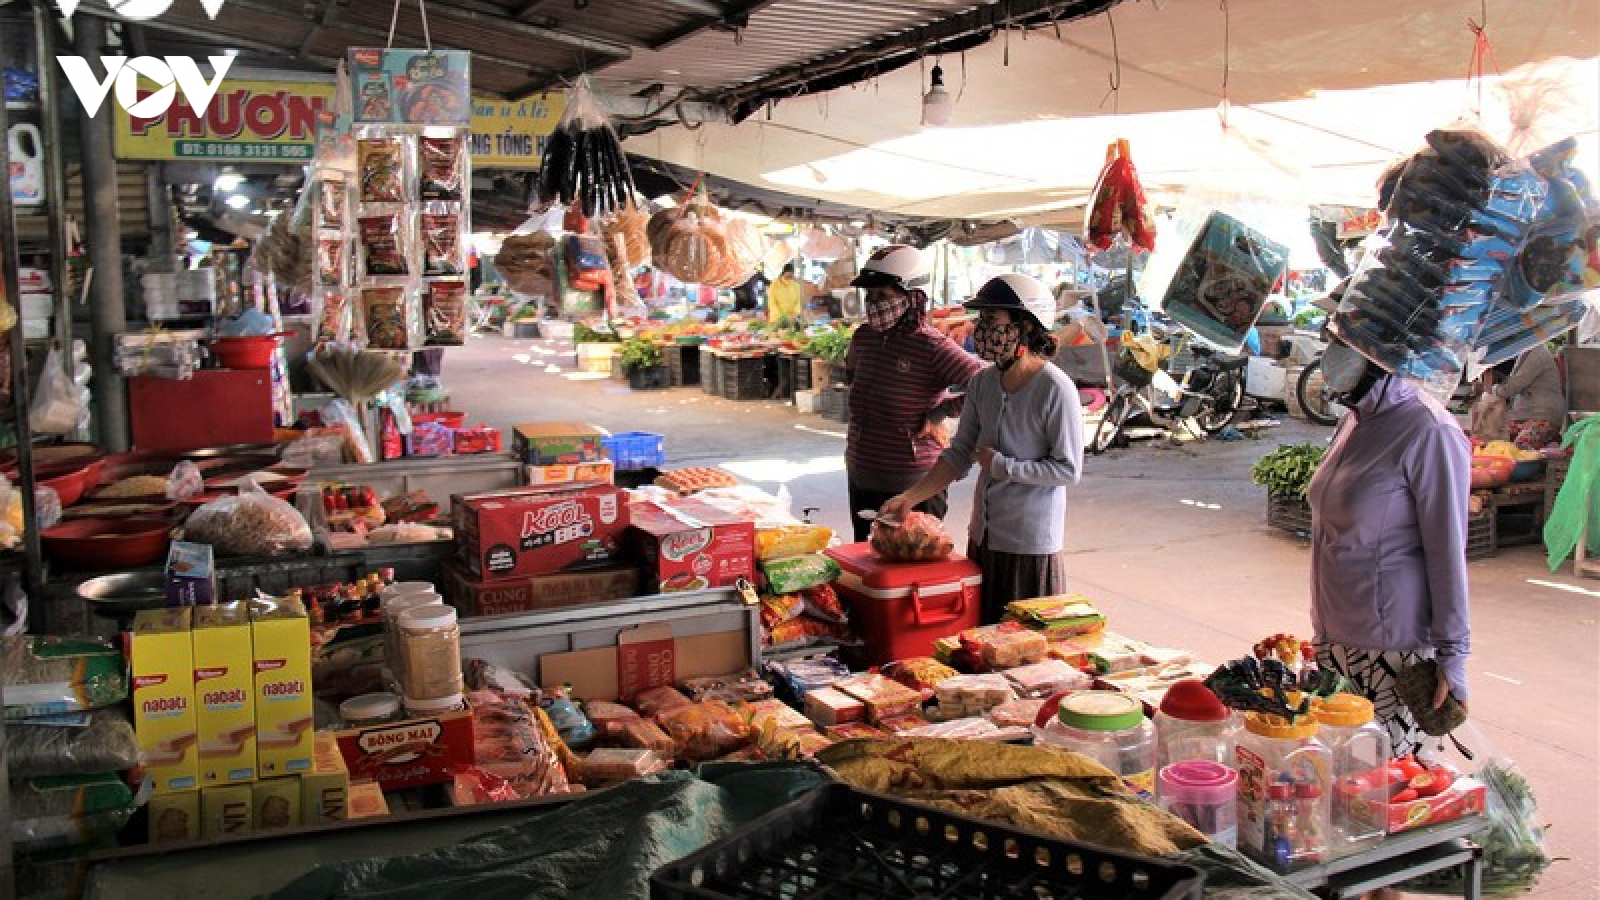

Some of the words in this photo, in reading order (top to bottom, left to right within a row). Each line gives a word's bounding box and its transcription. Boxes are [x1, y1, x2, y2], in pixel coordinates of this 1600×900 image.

[496, 126, 533, 156] TỔNG
[263, 680, 305, 696] nabati
[143, 696, 187, 712] nabati
[203, 689, 247, 705] nabati
[407, 727, 433, 741] MAI
